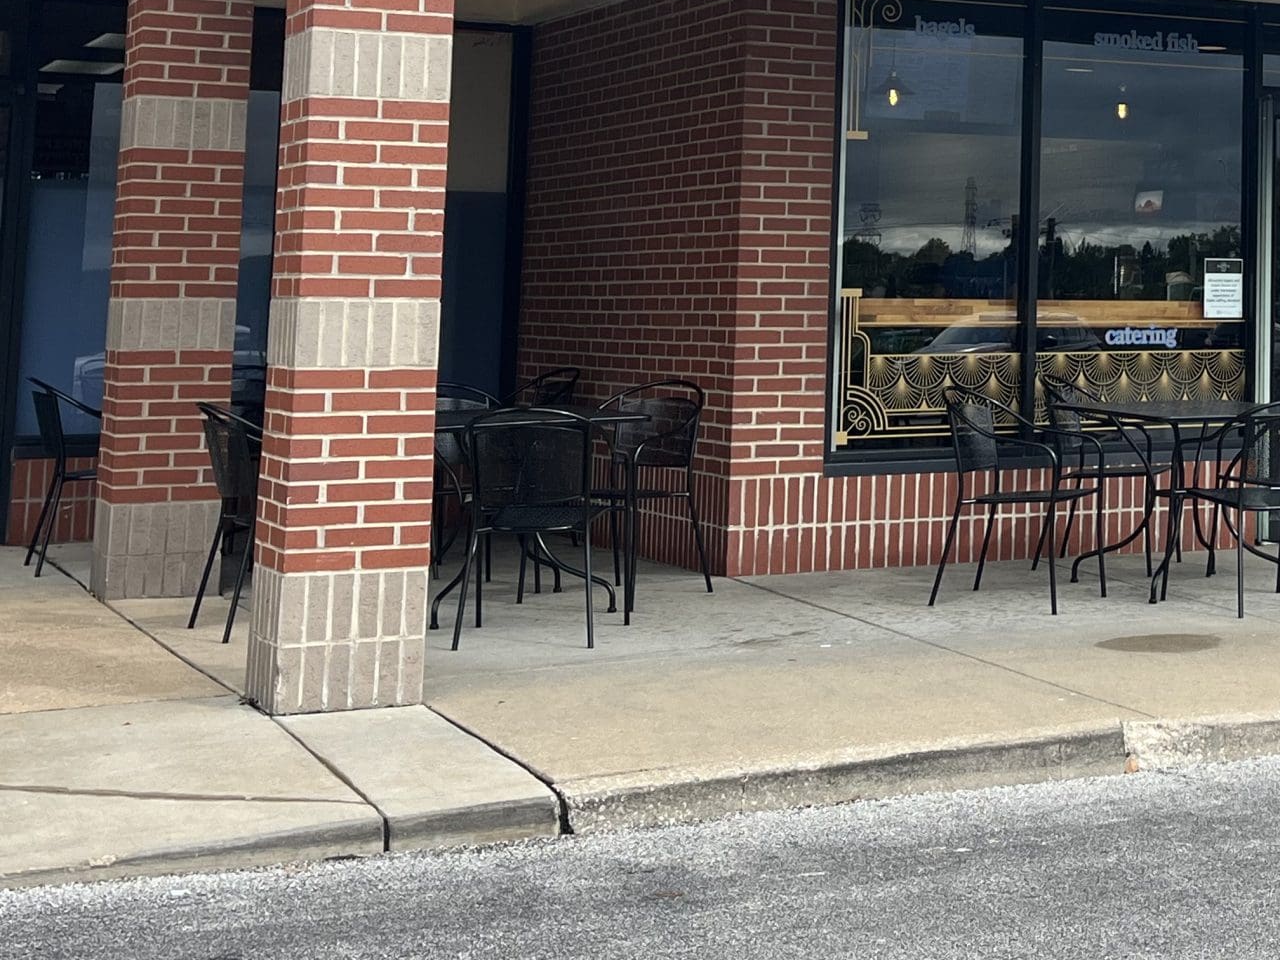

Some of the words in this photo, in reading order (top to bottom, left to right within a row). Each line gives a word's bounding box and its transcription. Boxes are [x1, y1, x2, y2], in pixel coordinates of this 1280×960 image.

[914, 15, 976, 37] bagels
[1094, 30, 1163, 51] smoked
[1166, 32, 1201, 53] fish
[1104, 324, 1178, 348] catering
